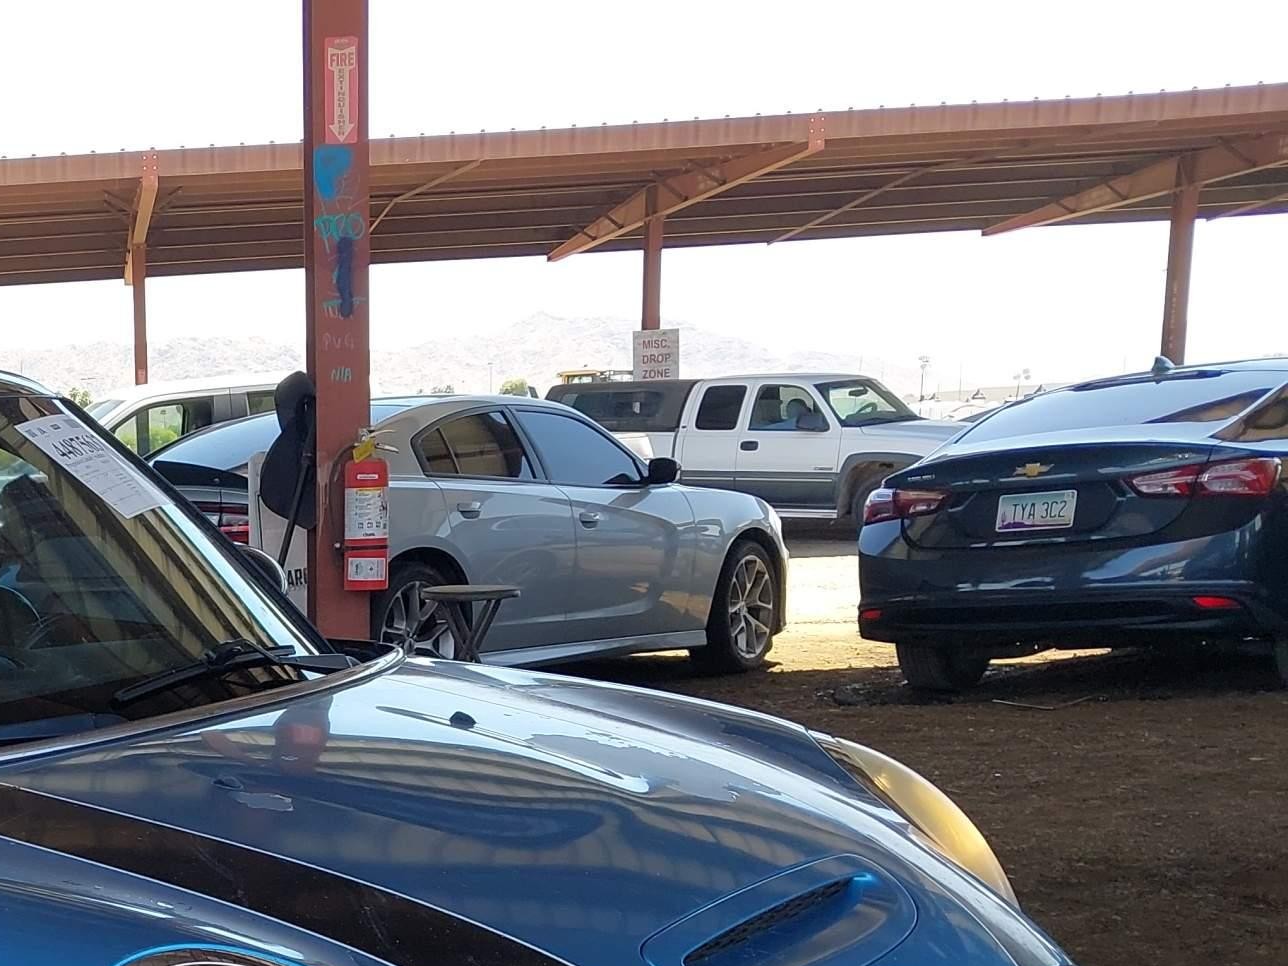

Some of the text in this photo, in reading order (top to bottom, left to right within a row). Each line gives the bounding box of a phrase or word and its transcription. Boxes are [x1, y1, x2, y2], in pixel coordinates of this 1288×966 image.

[329, 52, 354, 68] FIRE
[337, 68, 346, 136] EXTINGUISHER
[642, 338, 671, 350] MISC.
[642, 353, 672, 365] DROP
[642, 368, 672, 379] ZONE
[1012, 500, 1068, 521] TYA 3C2
